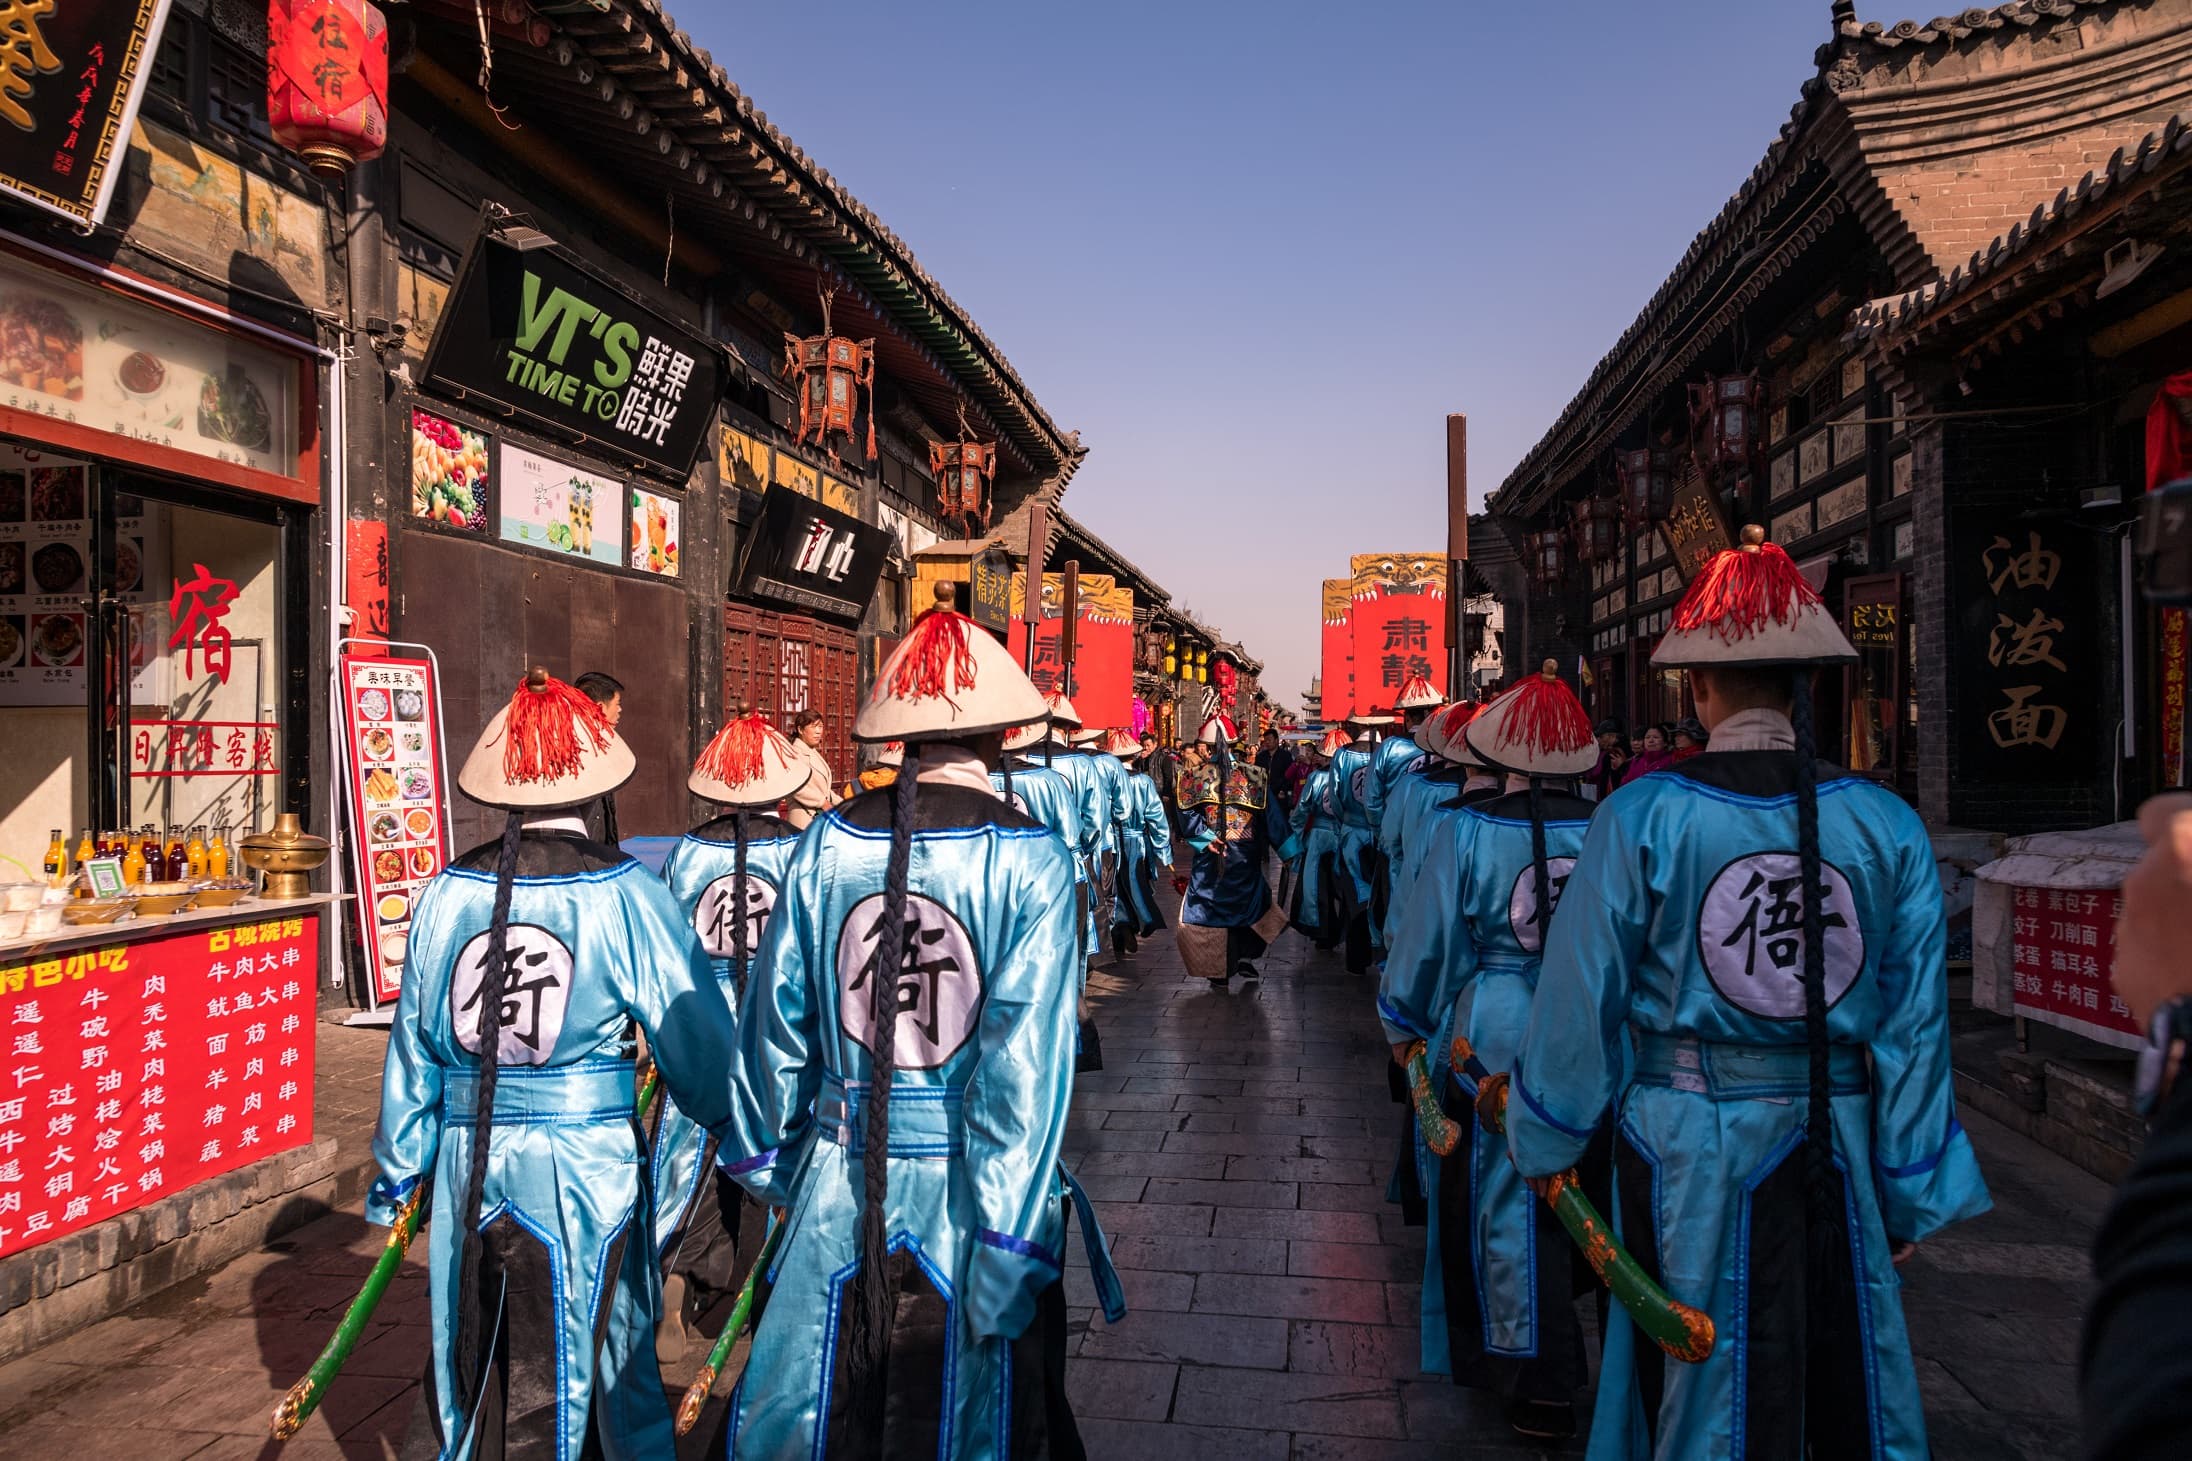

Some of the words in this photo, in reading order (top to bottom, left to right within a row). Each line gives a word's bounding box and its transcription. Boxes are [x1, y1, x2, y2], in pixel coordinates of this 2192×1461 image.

[312, 14, 351, 101] 住宿
[505, 350, 581, 407] TIME
[167, 562, 241, 685] 宿
[1983, 530, 2068, 751] 油泼面
[1382, 616, 1433, 688] 肃静
[2050, 920, 2098, 948] 刀削面
[206, 947, 301, 983] 牛肉大串
[206, 980, 300, 1019] 鱿鱼大串
[2051, 979, 2100, 1011] 牛肉面
[205, 1014, 300, 1057] 面筋串
[204, 1047, 299, 1091] 羊肉串
[202, 1080, 298, 1129] 猪肉串
[199, 1114, 297, 1163] 蔬菜串
